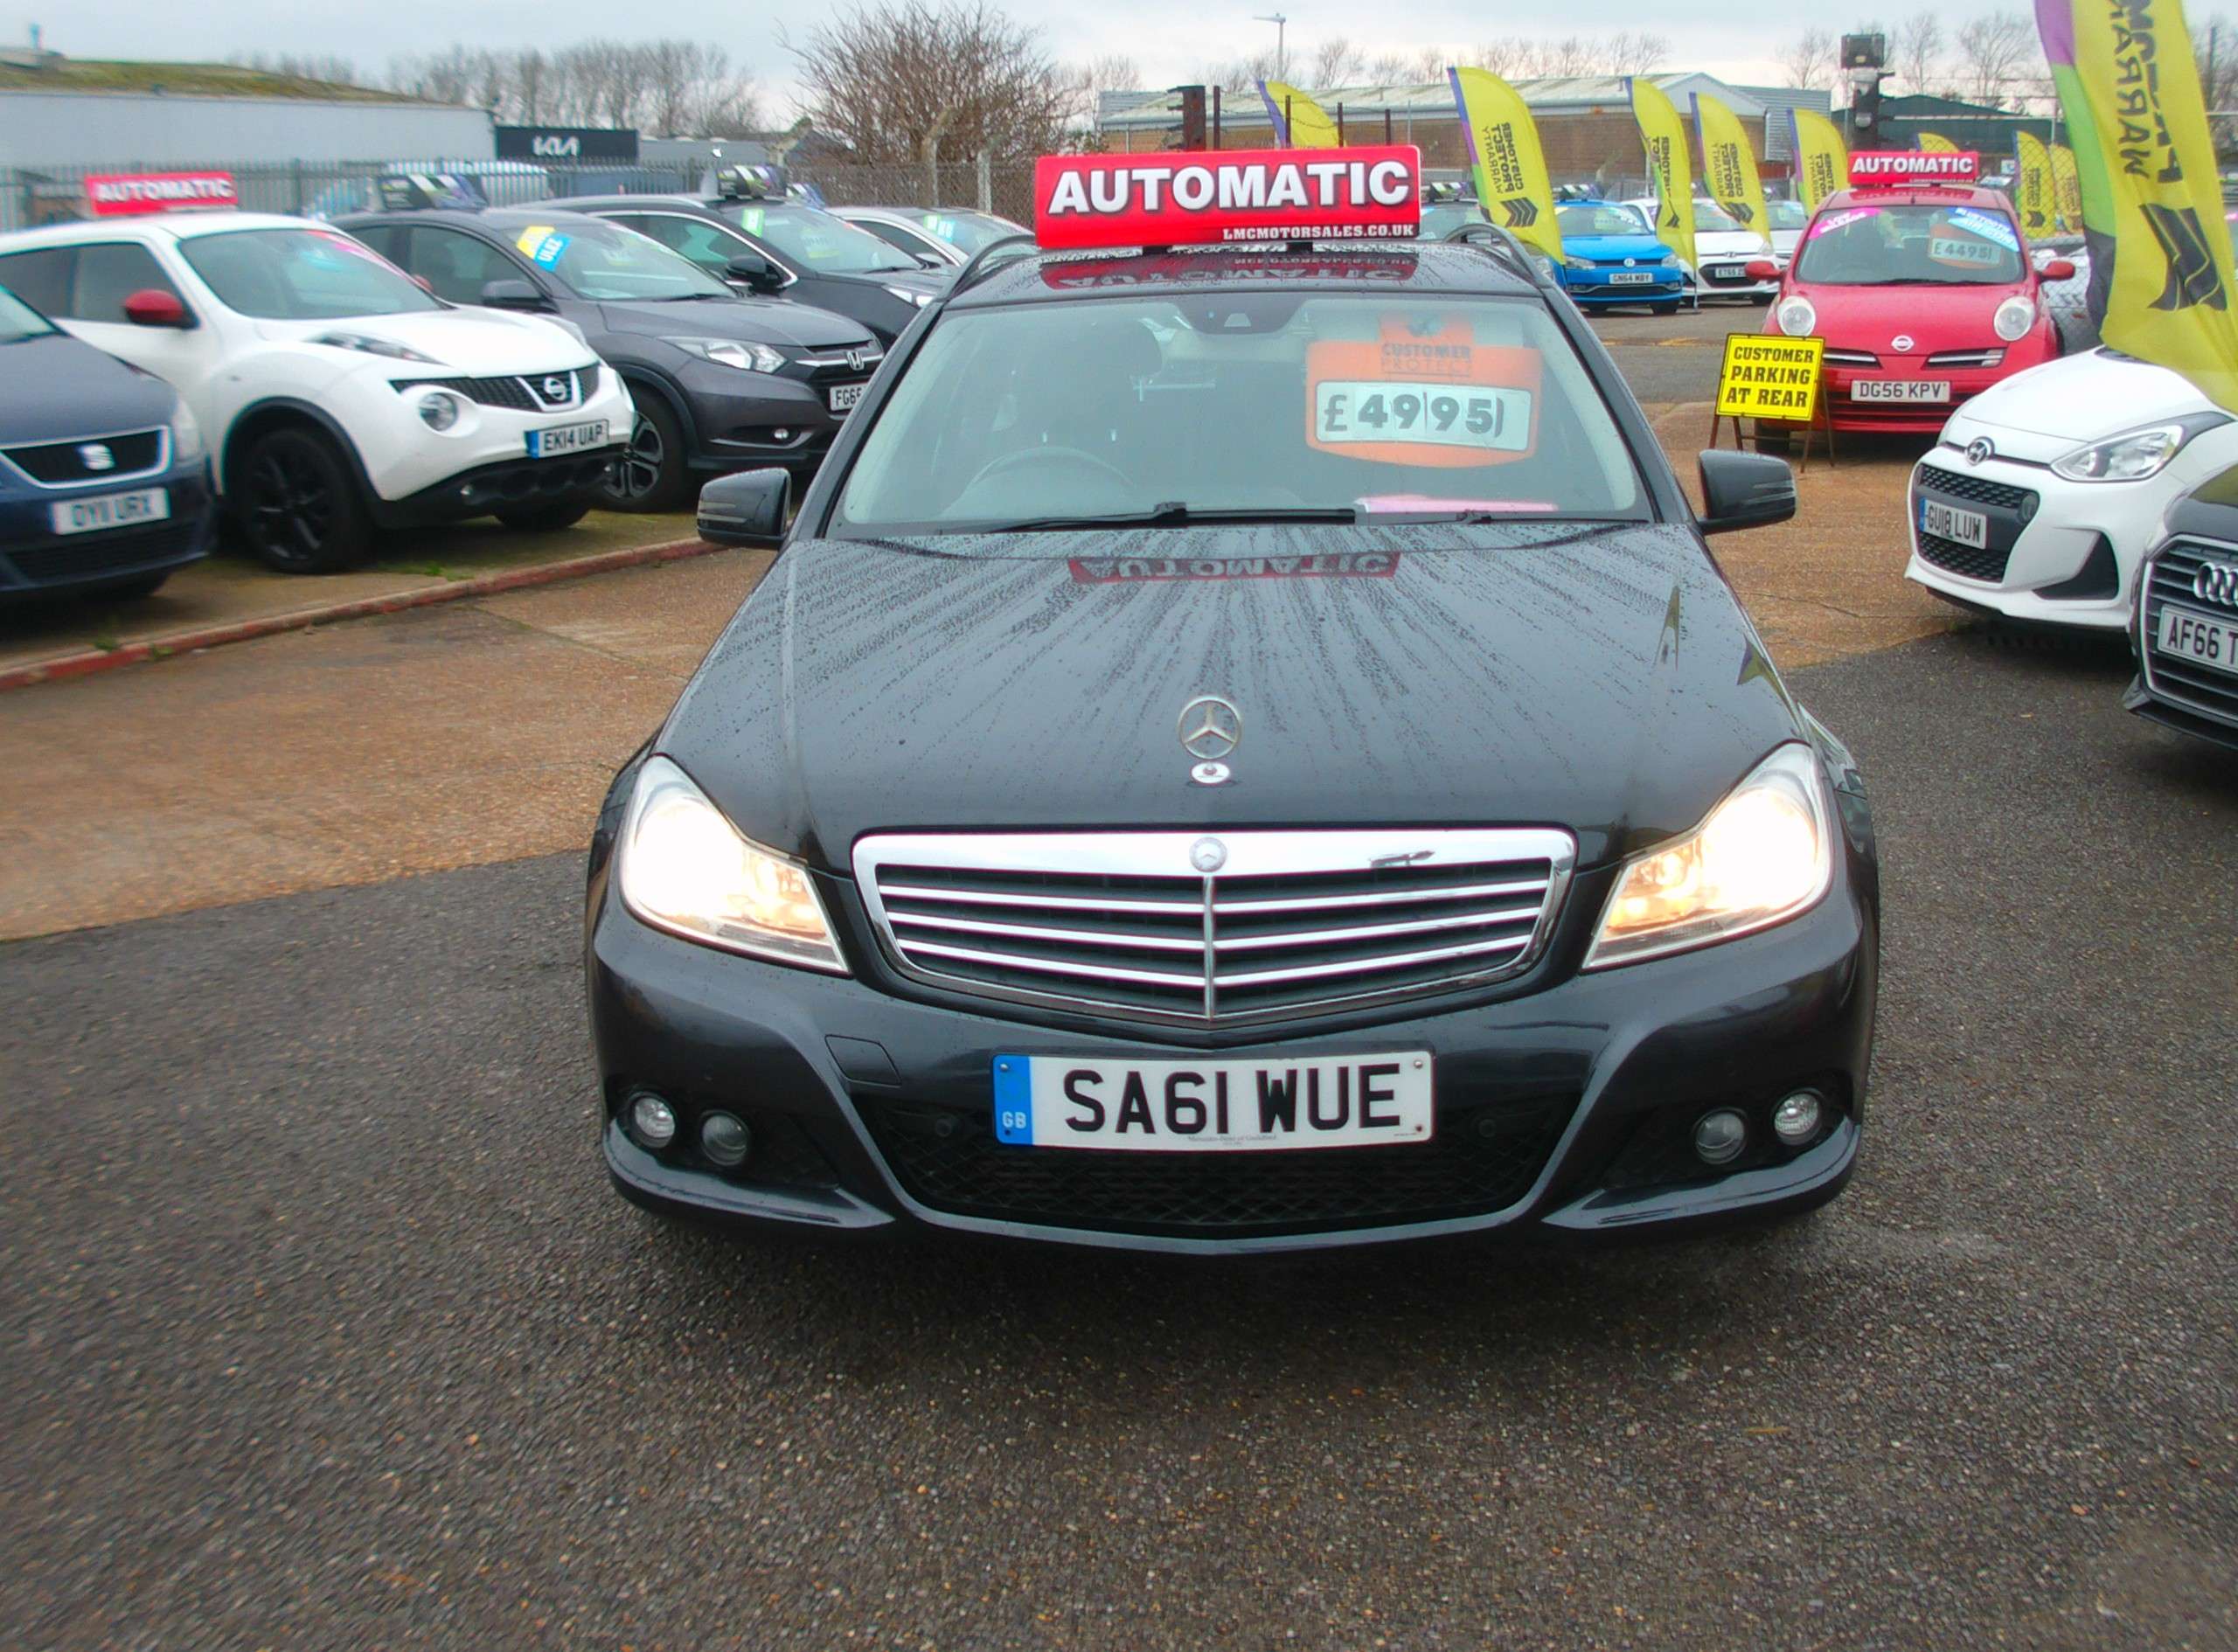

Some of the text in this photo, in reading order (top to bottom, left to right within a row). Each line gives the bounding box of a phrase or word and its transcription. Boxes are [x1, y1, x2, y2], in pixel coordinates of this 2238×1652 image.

[532, 136, 580, 156] KIA
[1852, 157, 1973, 173] AUTOMATIC
[93, 178, 235, 202] AUTOMATIC
[1048, 161, 1410, 214] AUTOMATIC
[1223, 225, 1414, 241] LMCMOTORSALES.CO.UK
[1734, 346, 1815, 364] CUSTOMER
[1730, 366, 1811, 385] PARKING
[1726, 387, 1808, 407] AT REAR
[1859, 382, 1942, 398] DG56 KPV
[2167, 616, 2221, 659] AF66
[1063, 1063, 1400, 1135] SA61 WUE
[1002, 1111, 1027, 1128] GB
